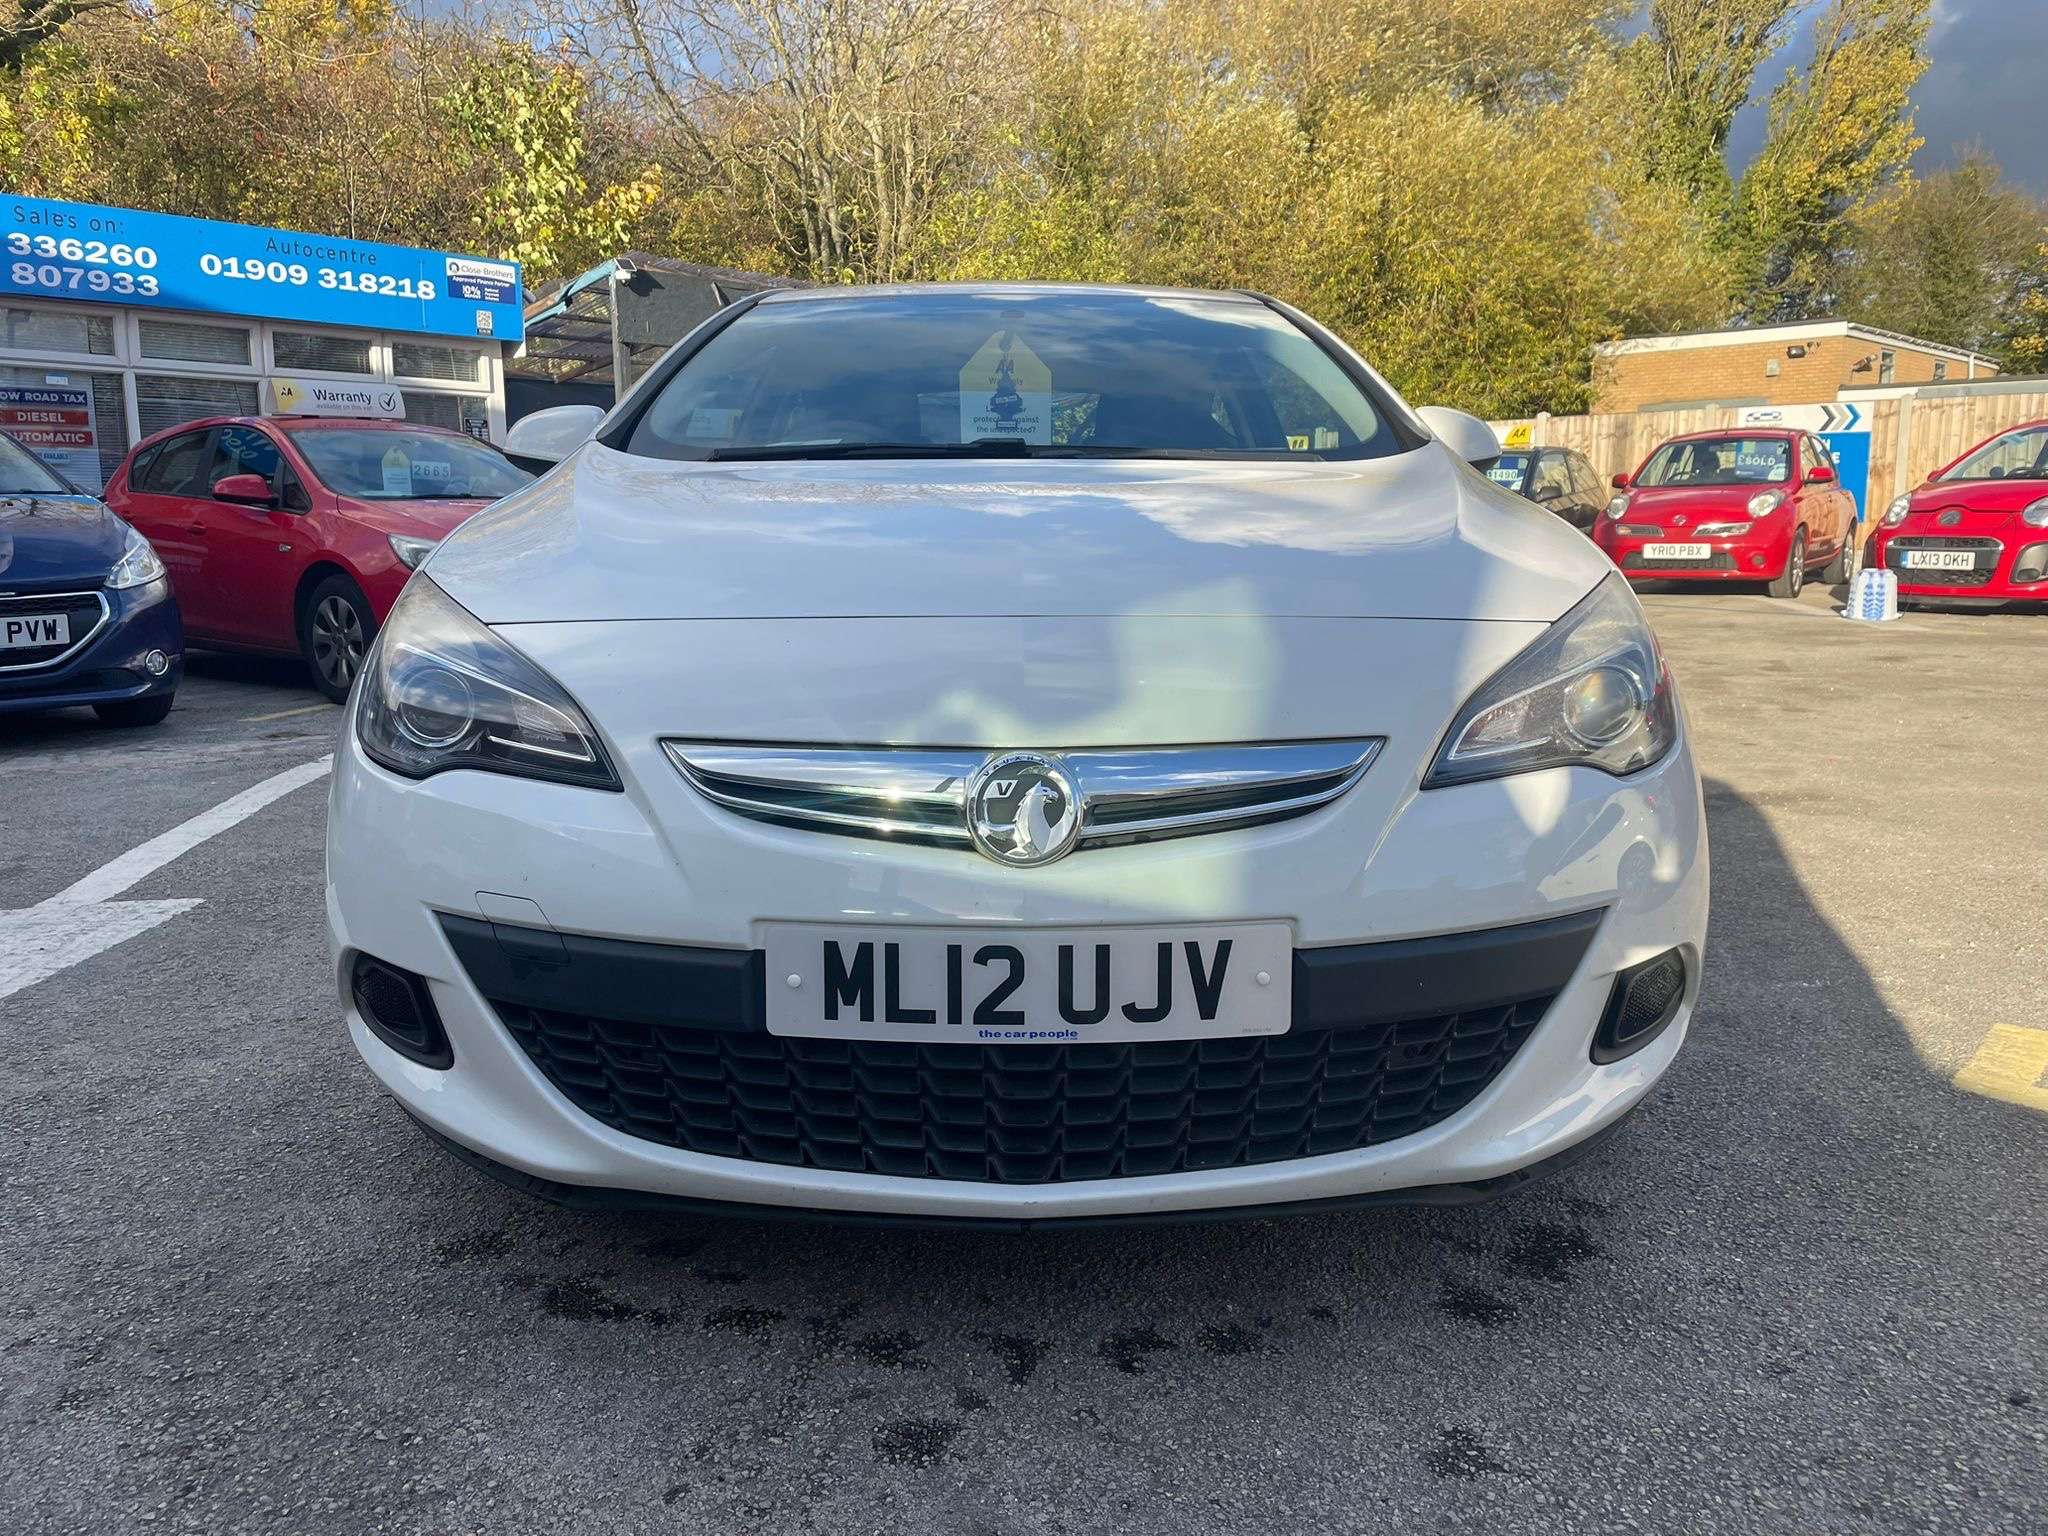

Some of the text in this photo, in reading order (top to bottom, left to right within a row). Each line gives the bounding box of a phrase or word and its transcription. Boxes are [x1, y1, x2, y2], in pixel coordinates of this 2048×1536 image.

[13, 205, 125, 235] Sales on:
[7, 231, 158, 269] 336260
[265, 237, 378, 266] Autocentre
[199, 253, 437, 301] 01909 318218
[460, 265, 514, 279] Close Brothers
[11, 262, 160, 297] 807933
[0, 391, 85, 403] OW ROAD TAX
[312, 388, 372, 406] Warranty
[17, 411, 66, 423] DIESEL
[1512, 427, 1526, 438] AA
[413, 464, 450, 476] 2665
[1651, 545, 1704, 556] YR10 PBX
[1912, 553, 1970, 567] LX13 OKH
[6, 619, 57, 644] PVW
[996, 782, 1013, 796] V
[824, 939, 1234, 1026] ML12 UJV
[978, 1029, 1002, 1038] the
[1029, 1028, 1079, 1039] people
